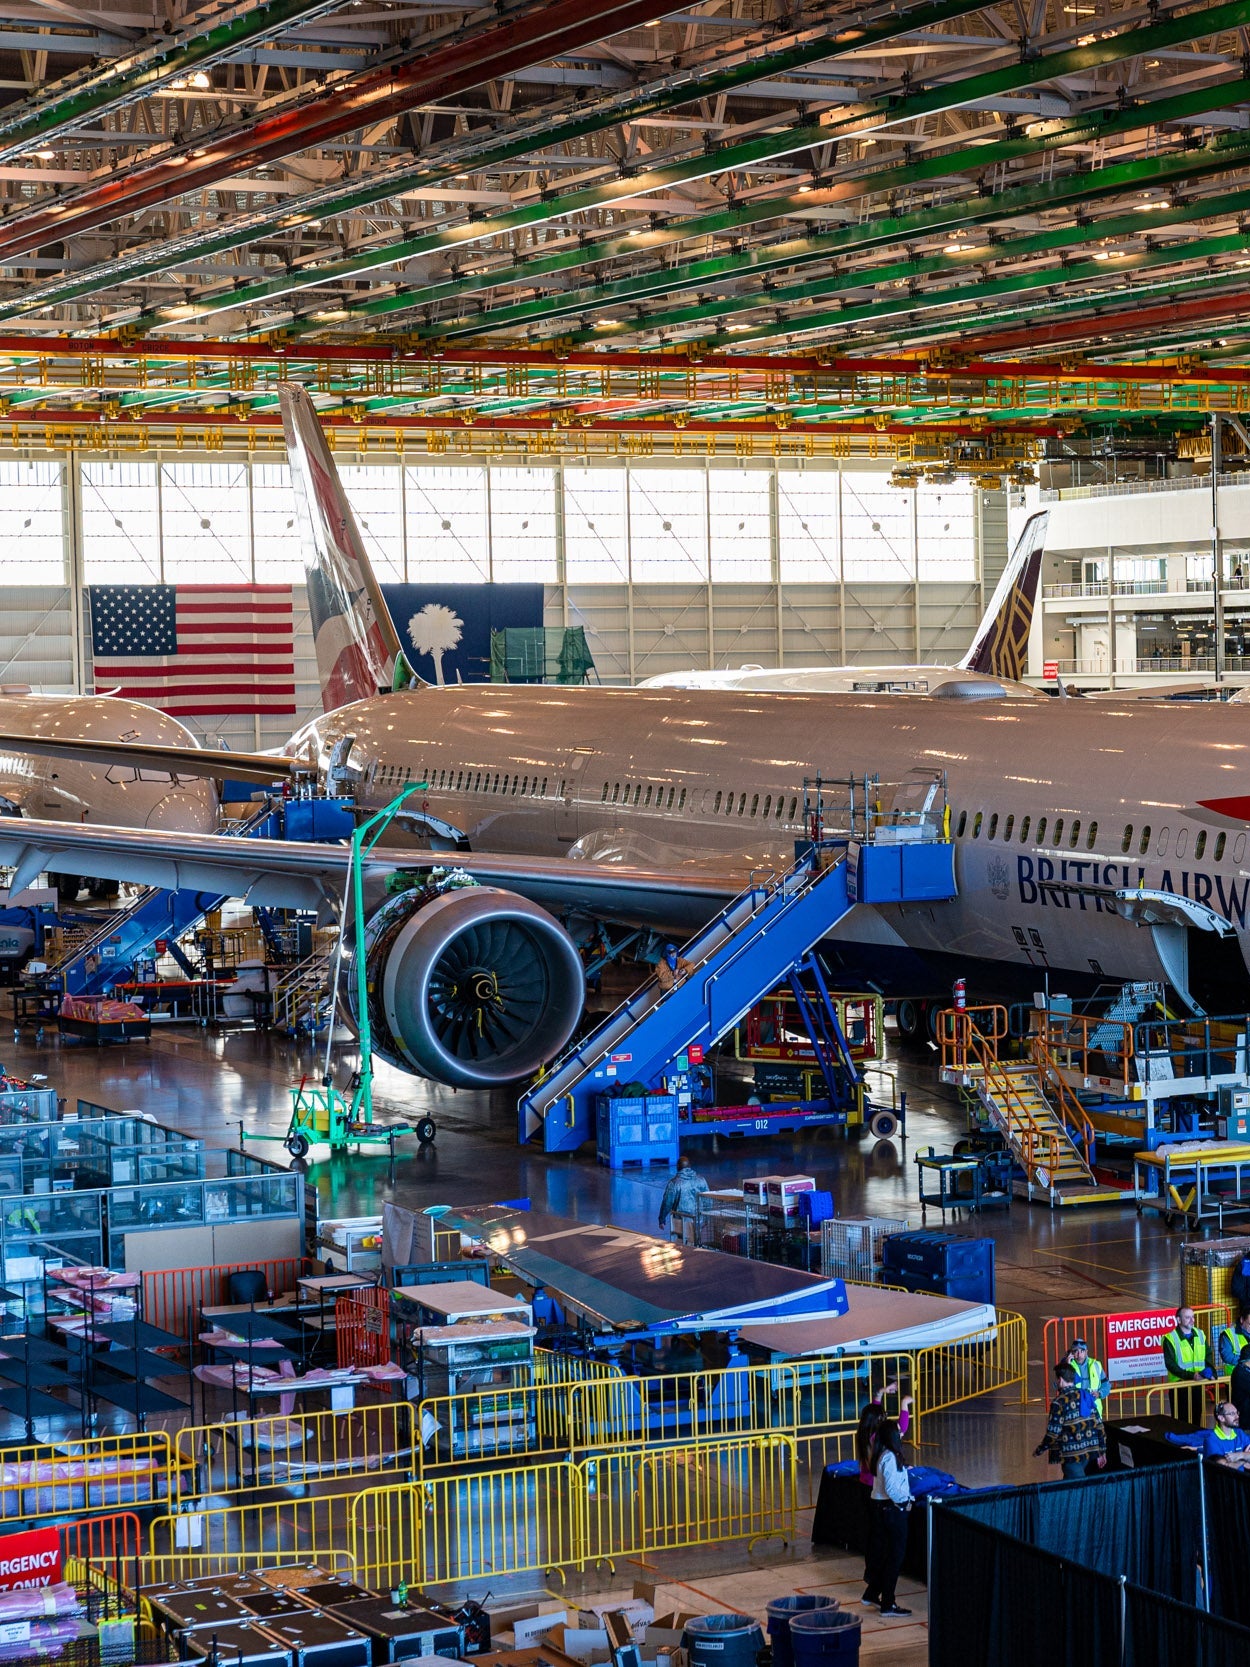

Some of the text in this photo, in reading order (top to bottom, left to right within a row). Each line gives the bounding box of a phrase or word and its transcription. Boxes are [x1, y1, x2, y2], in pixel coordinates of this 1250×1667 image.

[0, 938, 19, 948] nie
[755, 1119, 768, 1130] 012
[1108, 1315, 1178, 1333] EMERGENCY
[1116, 1335, 1163, 1351] EXIT ON
[0, 1550, 58, 1576] RGENCY
[13, 1575, 50, 1590] ONLY
